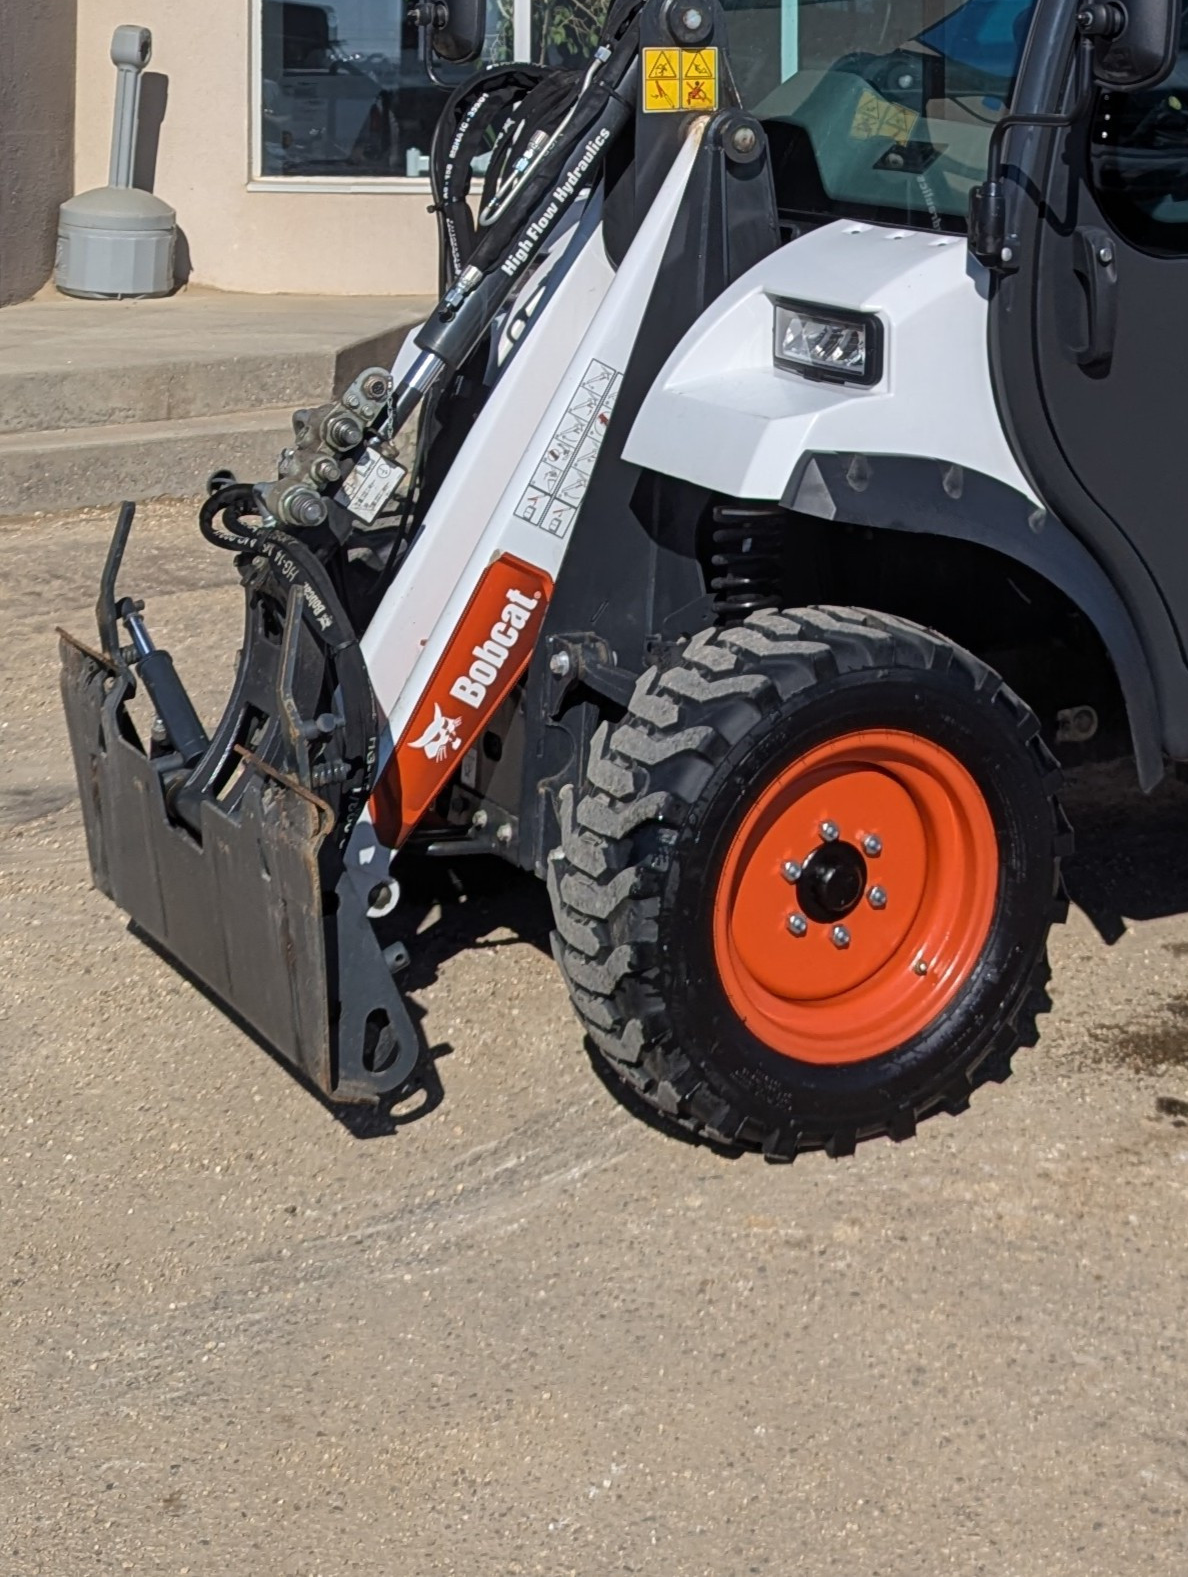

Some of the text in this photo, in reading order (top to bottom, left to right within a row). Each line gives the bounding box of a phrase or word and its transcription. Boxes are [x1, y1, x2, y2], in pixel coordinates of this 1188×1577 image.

[501, 240, 534, 277] High
[526, 201, 559, 242] Flow
[552, 128, 611, 204] Hydraulics
[449, 588, 538, 709] Bobcat
